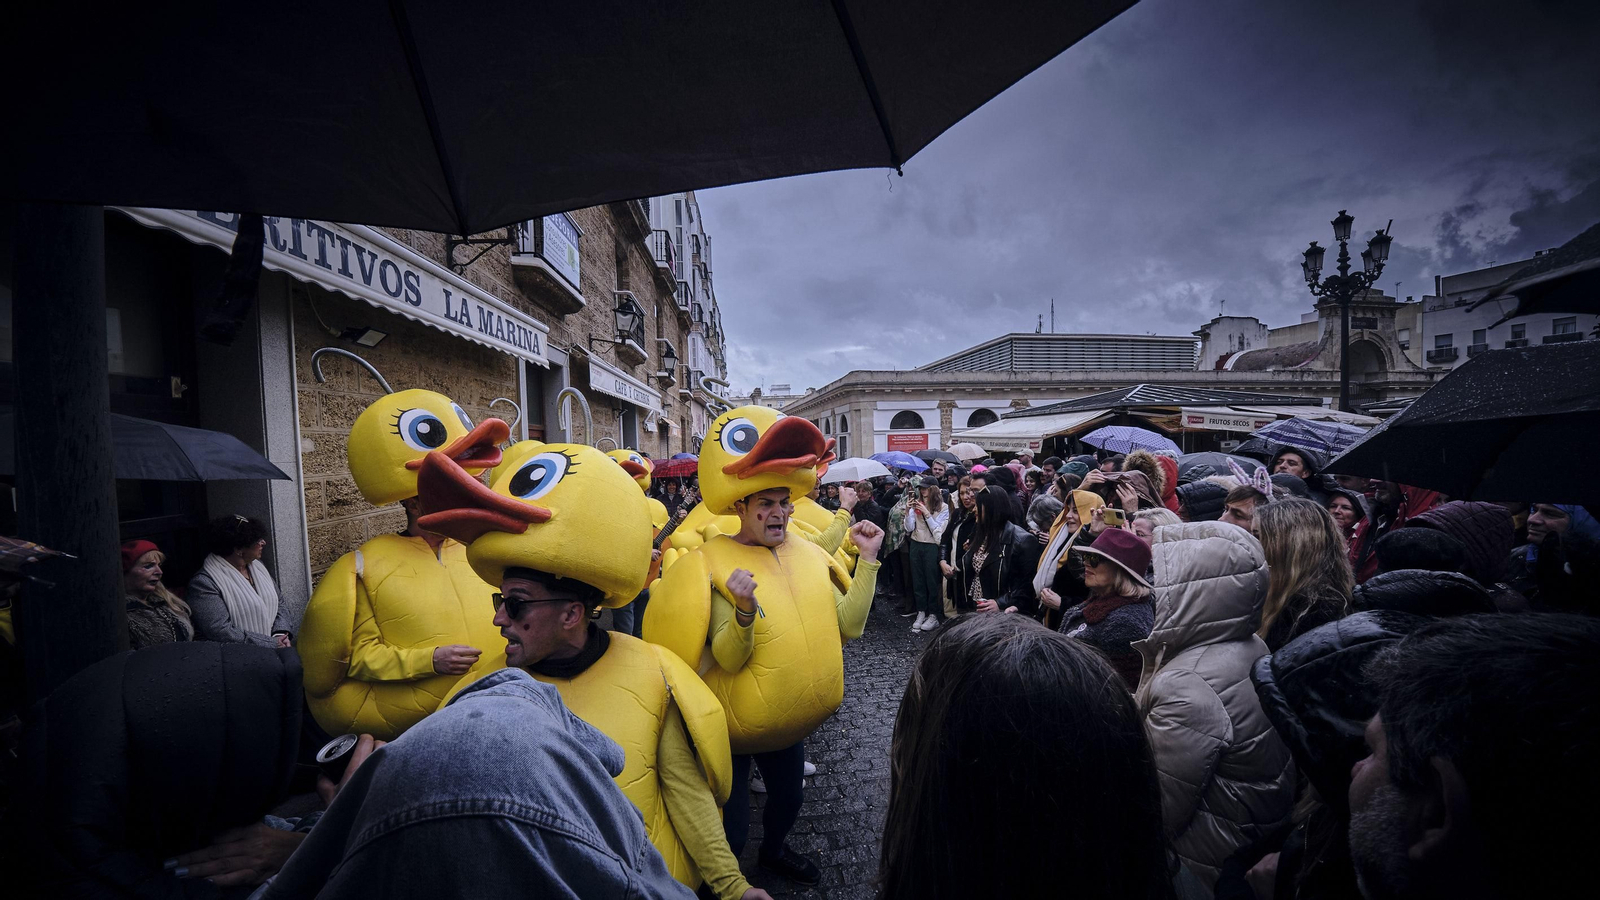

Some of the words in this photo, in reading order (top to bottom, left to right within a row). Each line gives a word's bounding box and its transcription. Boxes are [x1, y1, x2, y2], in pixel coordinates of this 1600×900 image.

[442, 288, 473, 328] LA
[477, 304, 541, 356] MARINA
[1209, 418, 1231, 426] FRUTOS
[1232, 419, 1250, 427] SECOS
